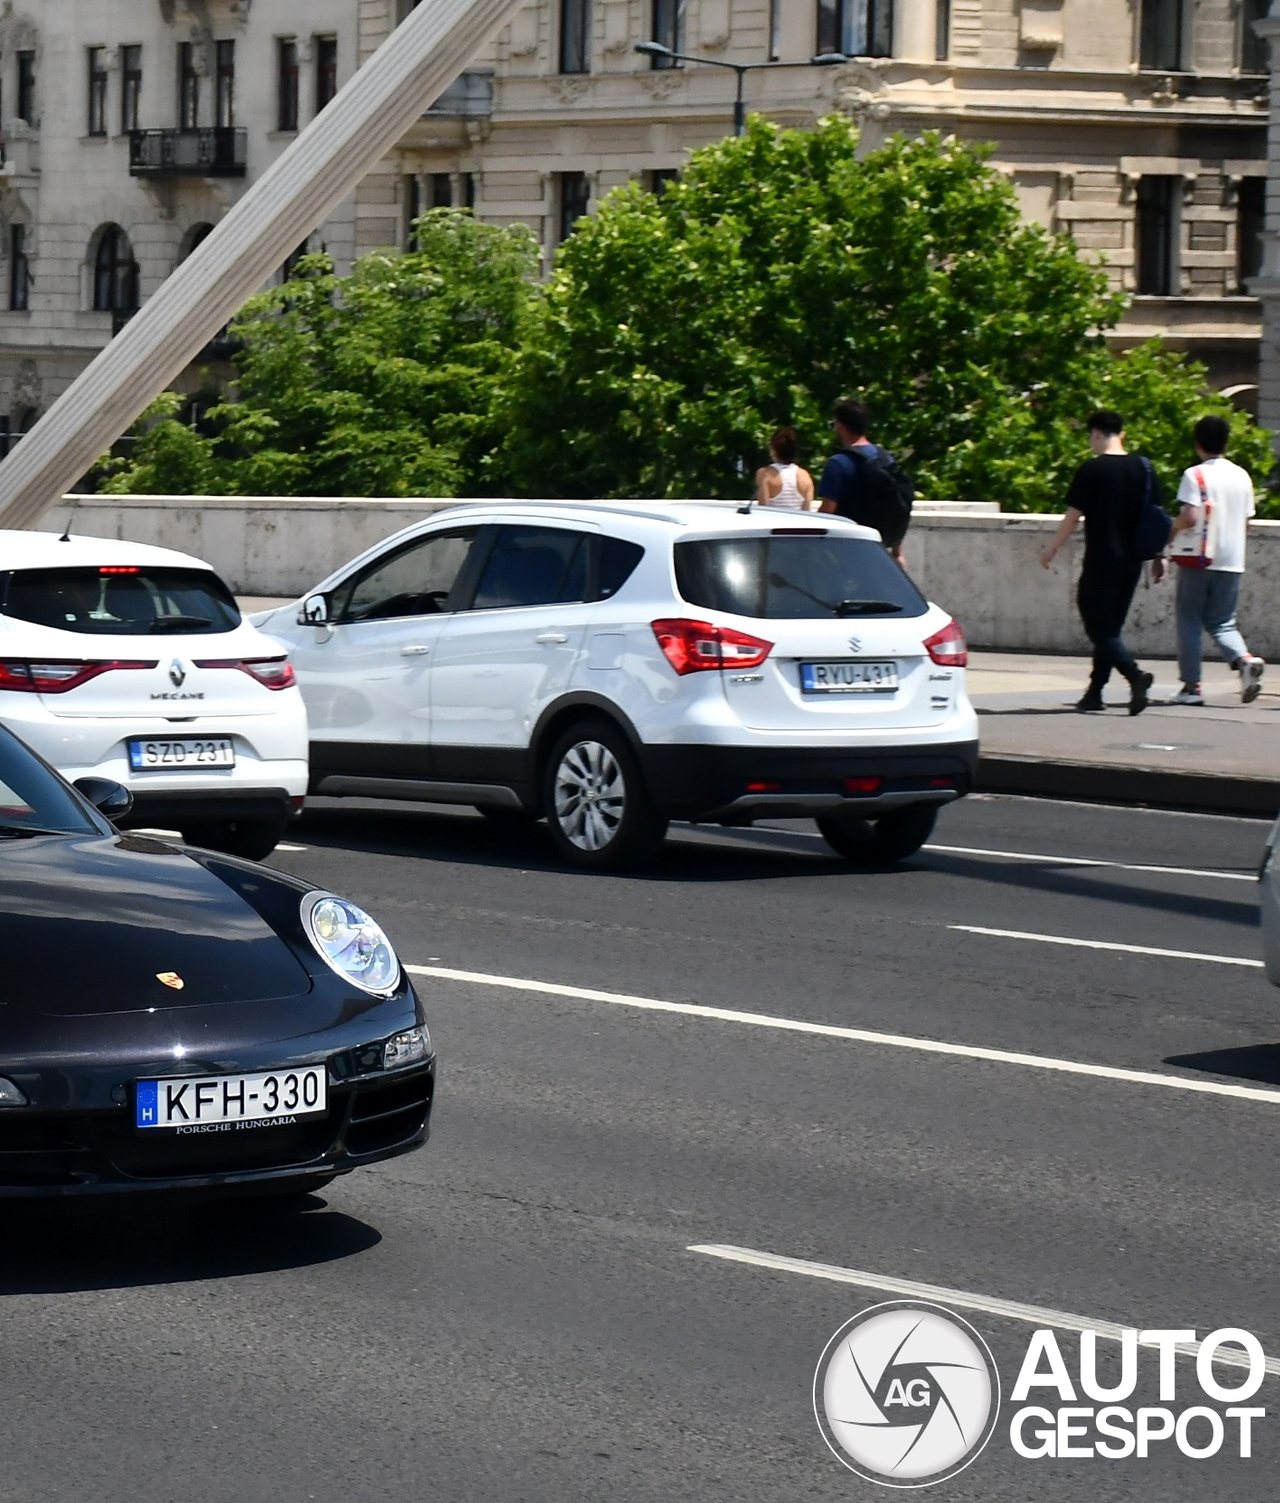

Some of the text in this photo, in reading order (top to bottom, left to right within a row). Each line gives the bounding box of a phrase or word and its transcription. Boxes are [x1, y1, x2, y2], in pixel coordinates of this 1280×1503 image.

[816, 666, 895, 686] RYU-431
[145, 742, 228, 763] SZD-231
[166, 1071, 318, 1121] KFH-330
[142, 1107, 153, 1121] H
[176, 1116, 297, 1135] PORSCHE HUNGARIA
